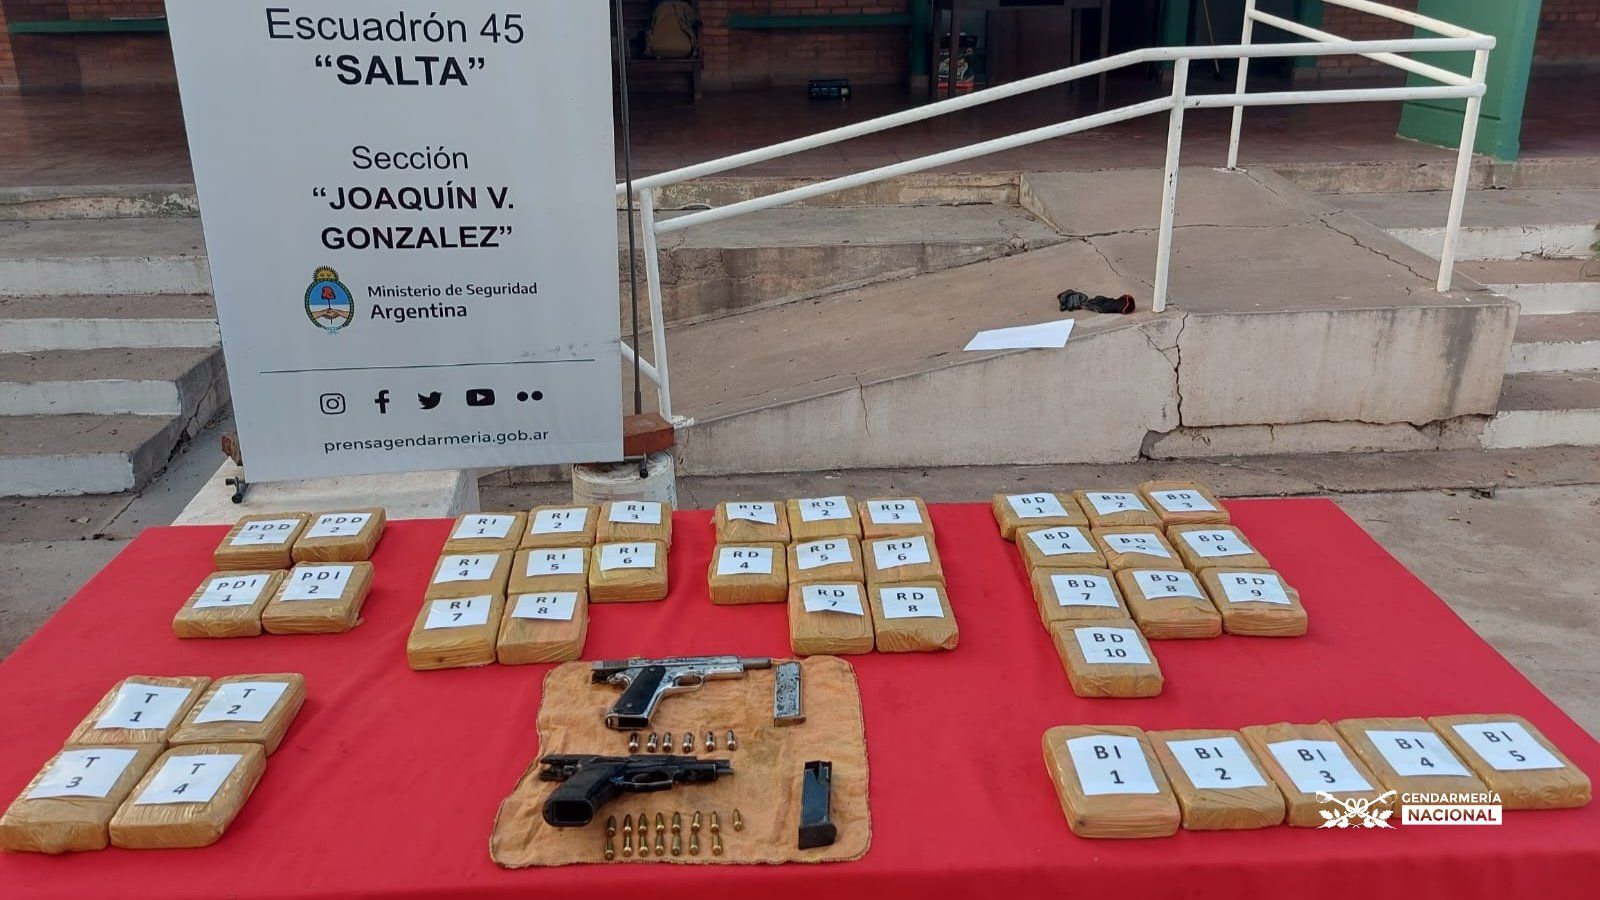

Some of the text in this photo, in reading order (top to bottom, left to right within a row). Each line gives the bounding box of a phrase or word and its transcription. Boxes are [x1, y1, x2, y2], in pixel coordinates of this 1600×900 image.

[266, 8, 524, 44] Escuadrón 45
[315, 55, 485, 86] “SALTA”
[353, 146, 468, 169] Sección
[313, 180, 514, 211] “JOAQUÍN V.
[322, 226, 512, 249] GONZALEZ”
[368, 282, 537, 298] Ministerio de Seguridad
[371, 303, 467, 322] Argentina
[324, 430, 548, 453] prensagendarmeria.gob.ar
[898, 553, 907, 561] 6
[308, 586, 318, 594] 2
[1251, 589, 1262, 597] 9
[1081, 592, 1091, 601] 7
[453, 613, 463, 621] 7
[1104, 648, 1127, 658] 10
[145, 693, 158, 703] T
[242, 688, 256, 698] T
[227, 705, 241, 714] 2
[129, 712, 143, 722] 1
[1509, 750, 1526, 762] 5
[85, 757, 100, 768] T
[1420, 757, 1434, 768] 4
[191, 763, 206, 774] T
[1215, 768, 1231, 780] 2
[66, 776, 83, 788] 3
[1110, 770, 1124, 784] 1
[1319, 771, 1336, 784] 3
[173, 784, 188, 795] 4
